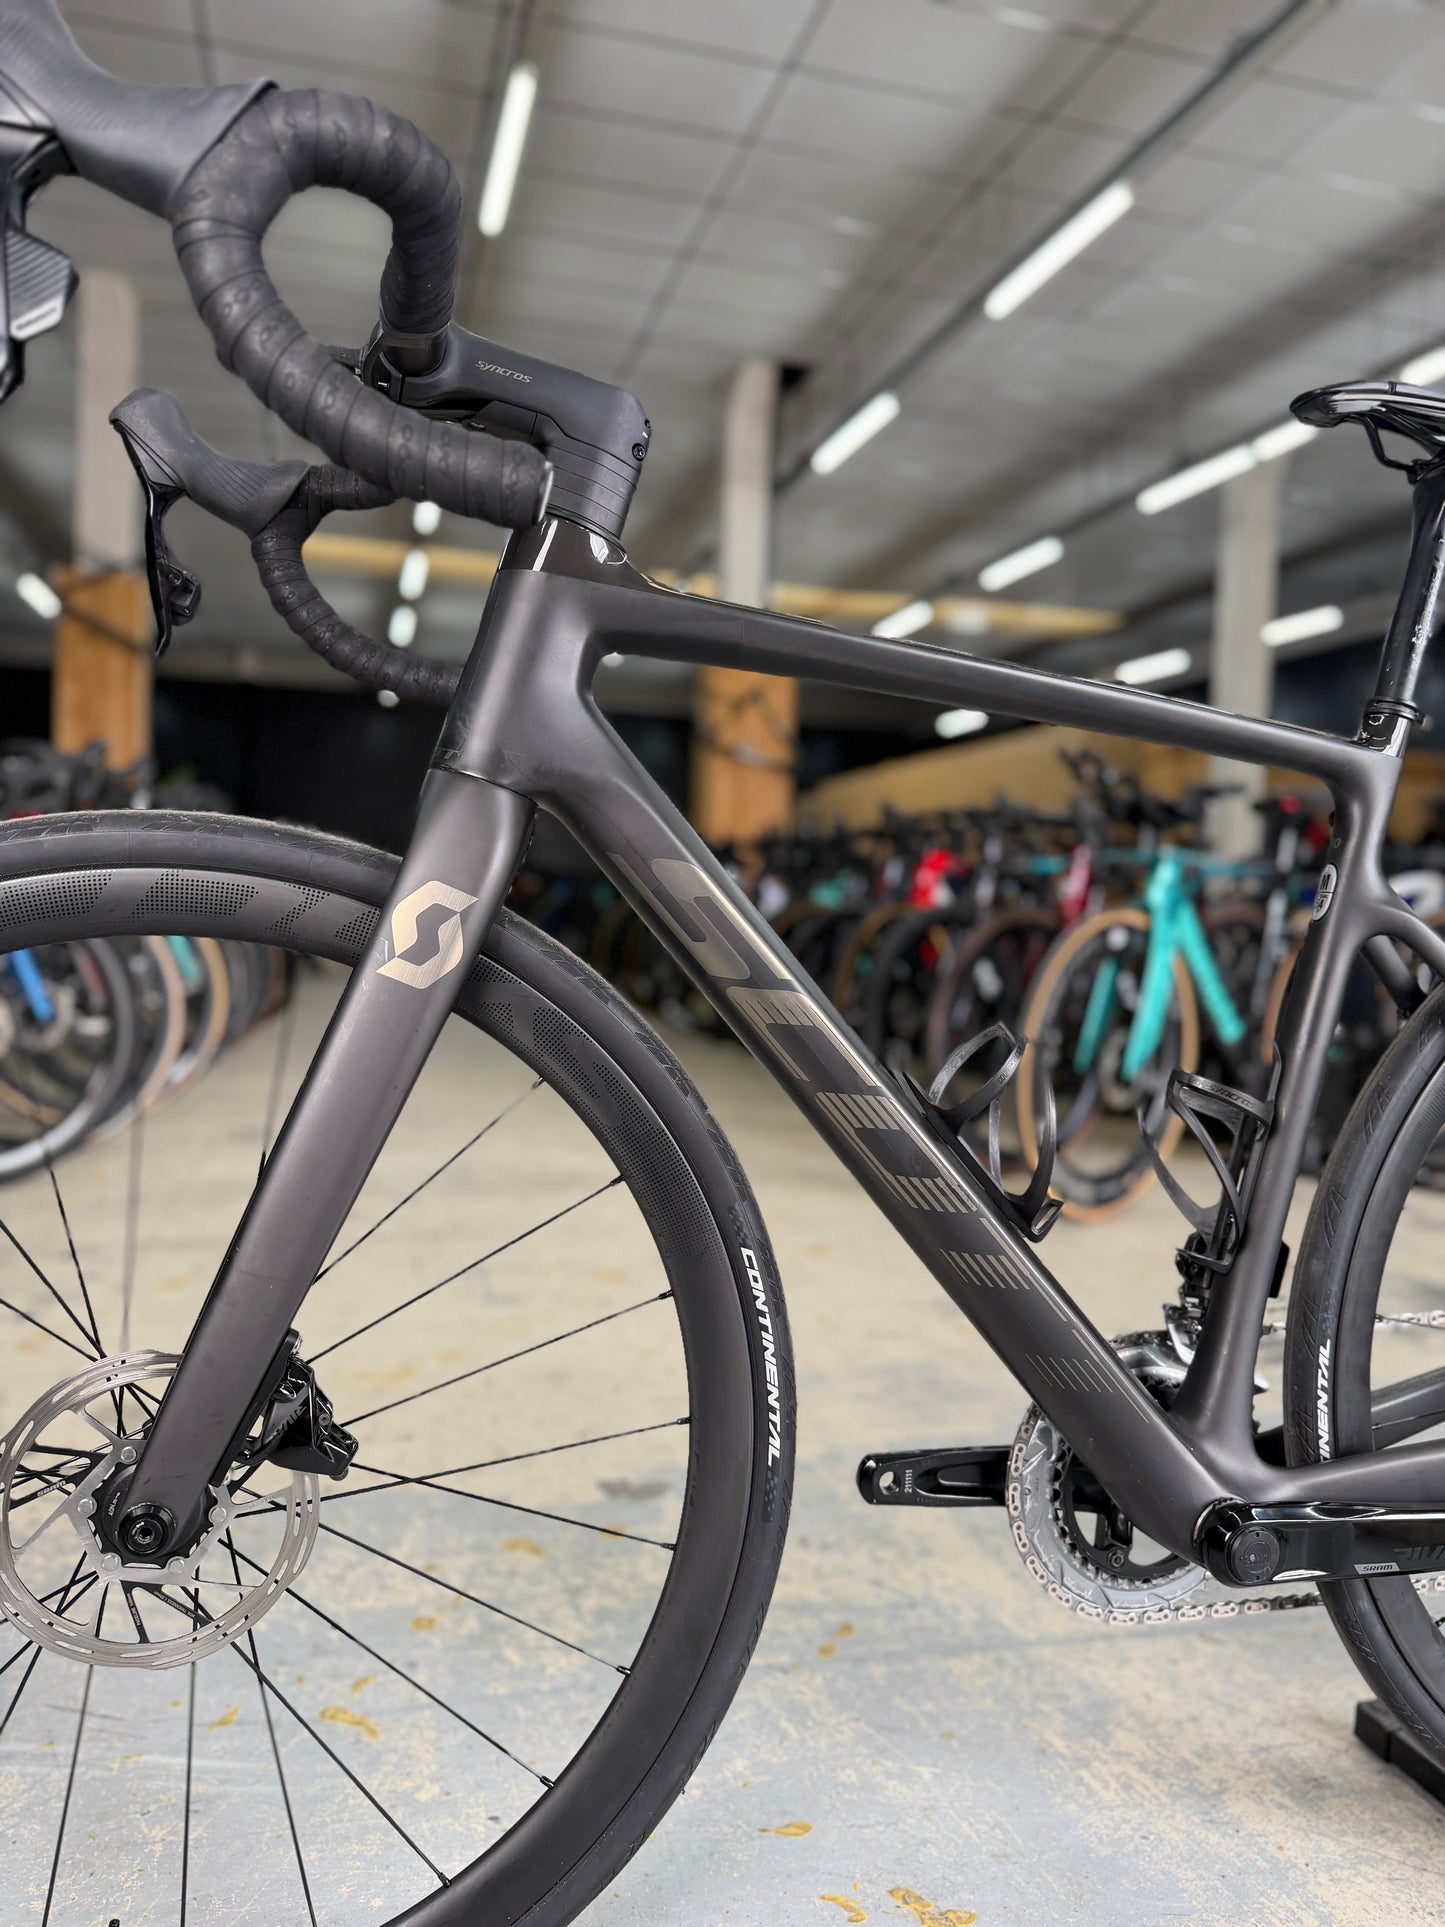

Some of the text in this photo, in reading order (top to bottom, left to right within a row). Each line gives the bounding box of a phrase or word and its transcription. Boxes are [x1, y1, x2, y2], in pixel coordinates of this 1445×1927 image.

[475, 360, 533, 383] syncros
[741, 1246, 782, 1468] CONTINENTAL
[1317, 1338, 1331, 1462] INENTAL
[1362, 1564, 1393, 1572] SRAM
